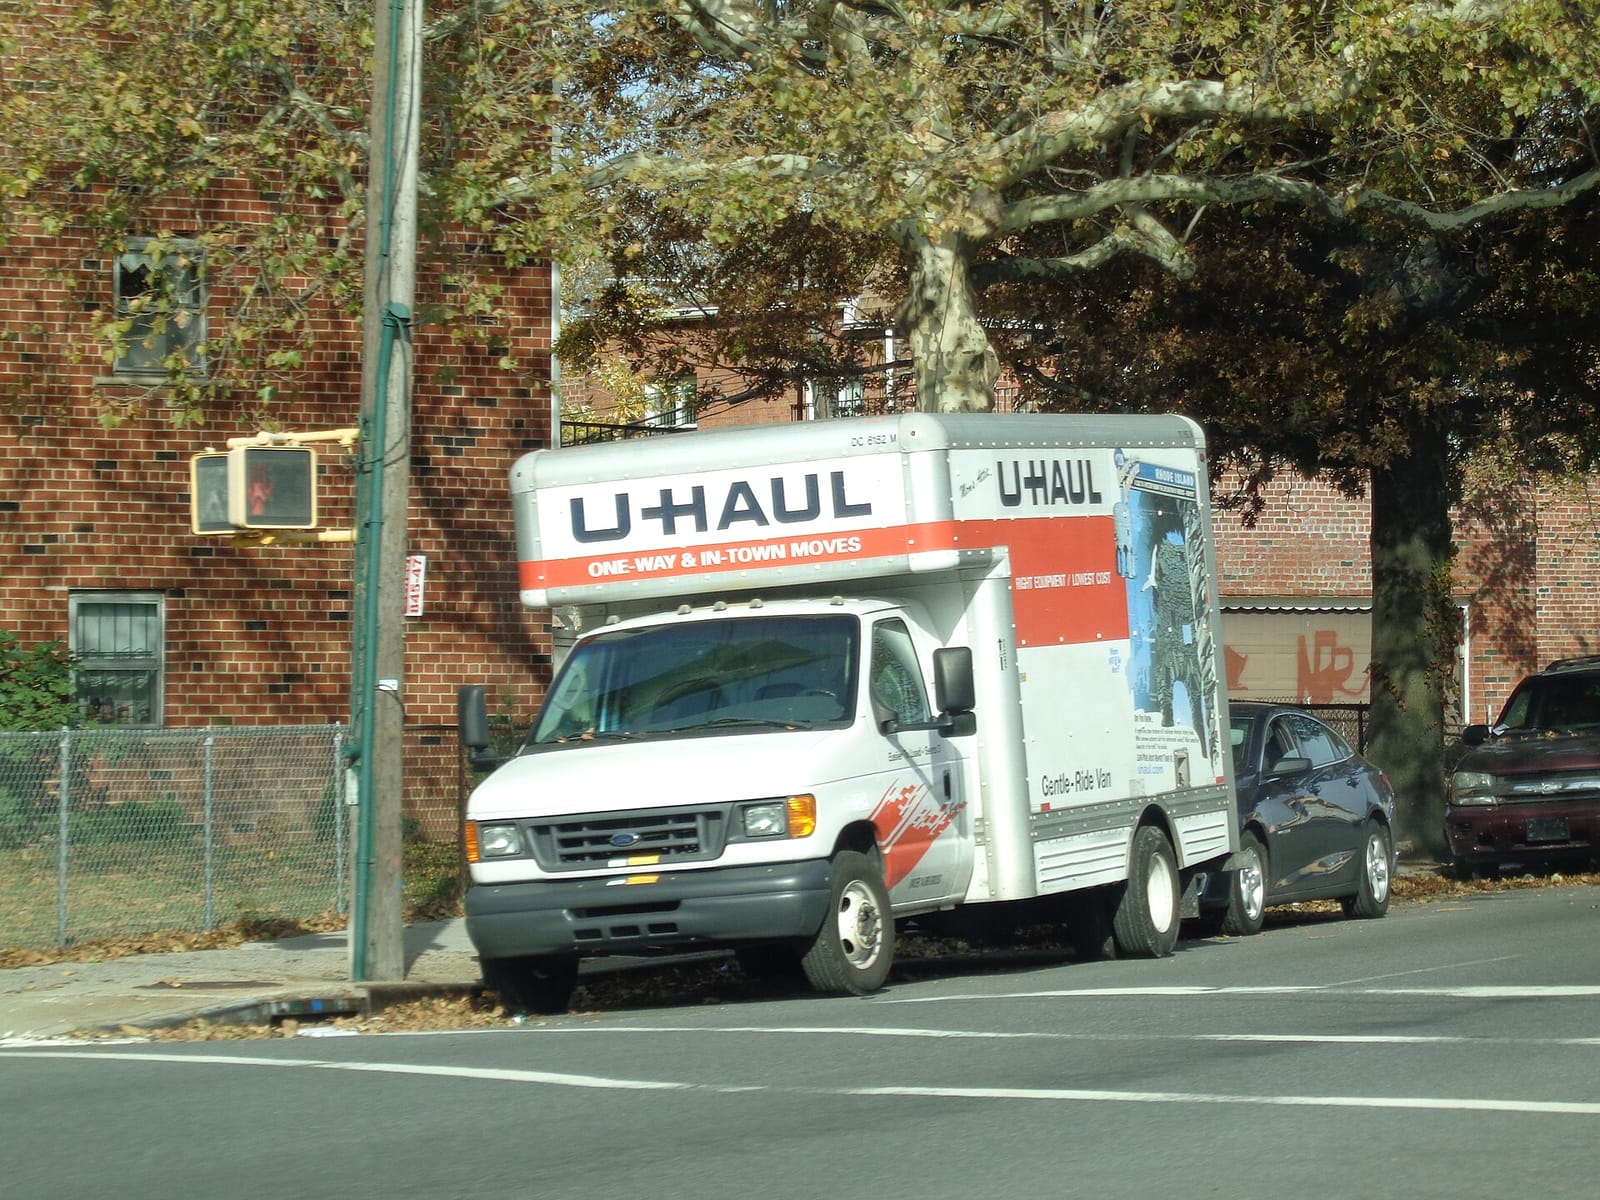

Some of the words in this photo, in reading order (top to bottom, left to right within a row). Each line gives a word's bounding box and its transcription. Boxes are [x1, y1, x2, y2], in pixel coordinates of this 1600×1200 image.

[851, 436, 864, 447] DC
[1155, 468, 1174, 483] RHODE
[1174, 472, 1194, 486] ISLAND
[588, 553, 677, 578] ONE-WAY
[680, 552, 698, 568] &
[700, 543, 787, 567] IN-TOWN
[790, 536, 862, 557] MOVES
[1015, 576, 1033, 590] RIGHT
[1034, 574, 1066, 589] EQUIPMENT
[1072, 572, 1095, 586] LOWEST
[1096, 571, 1111, 585] COST
[1096, 768, 1112, 789] Van
